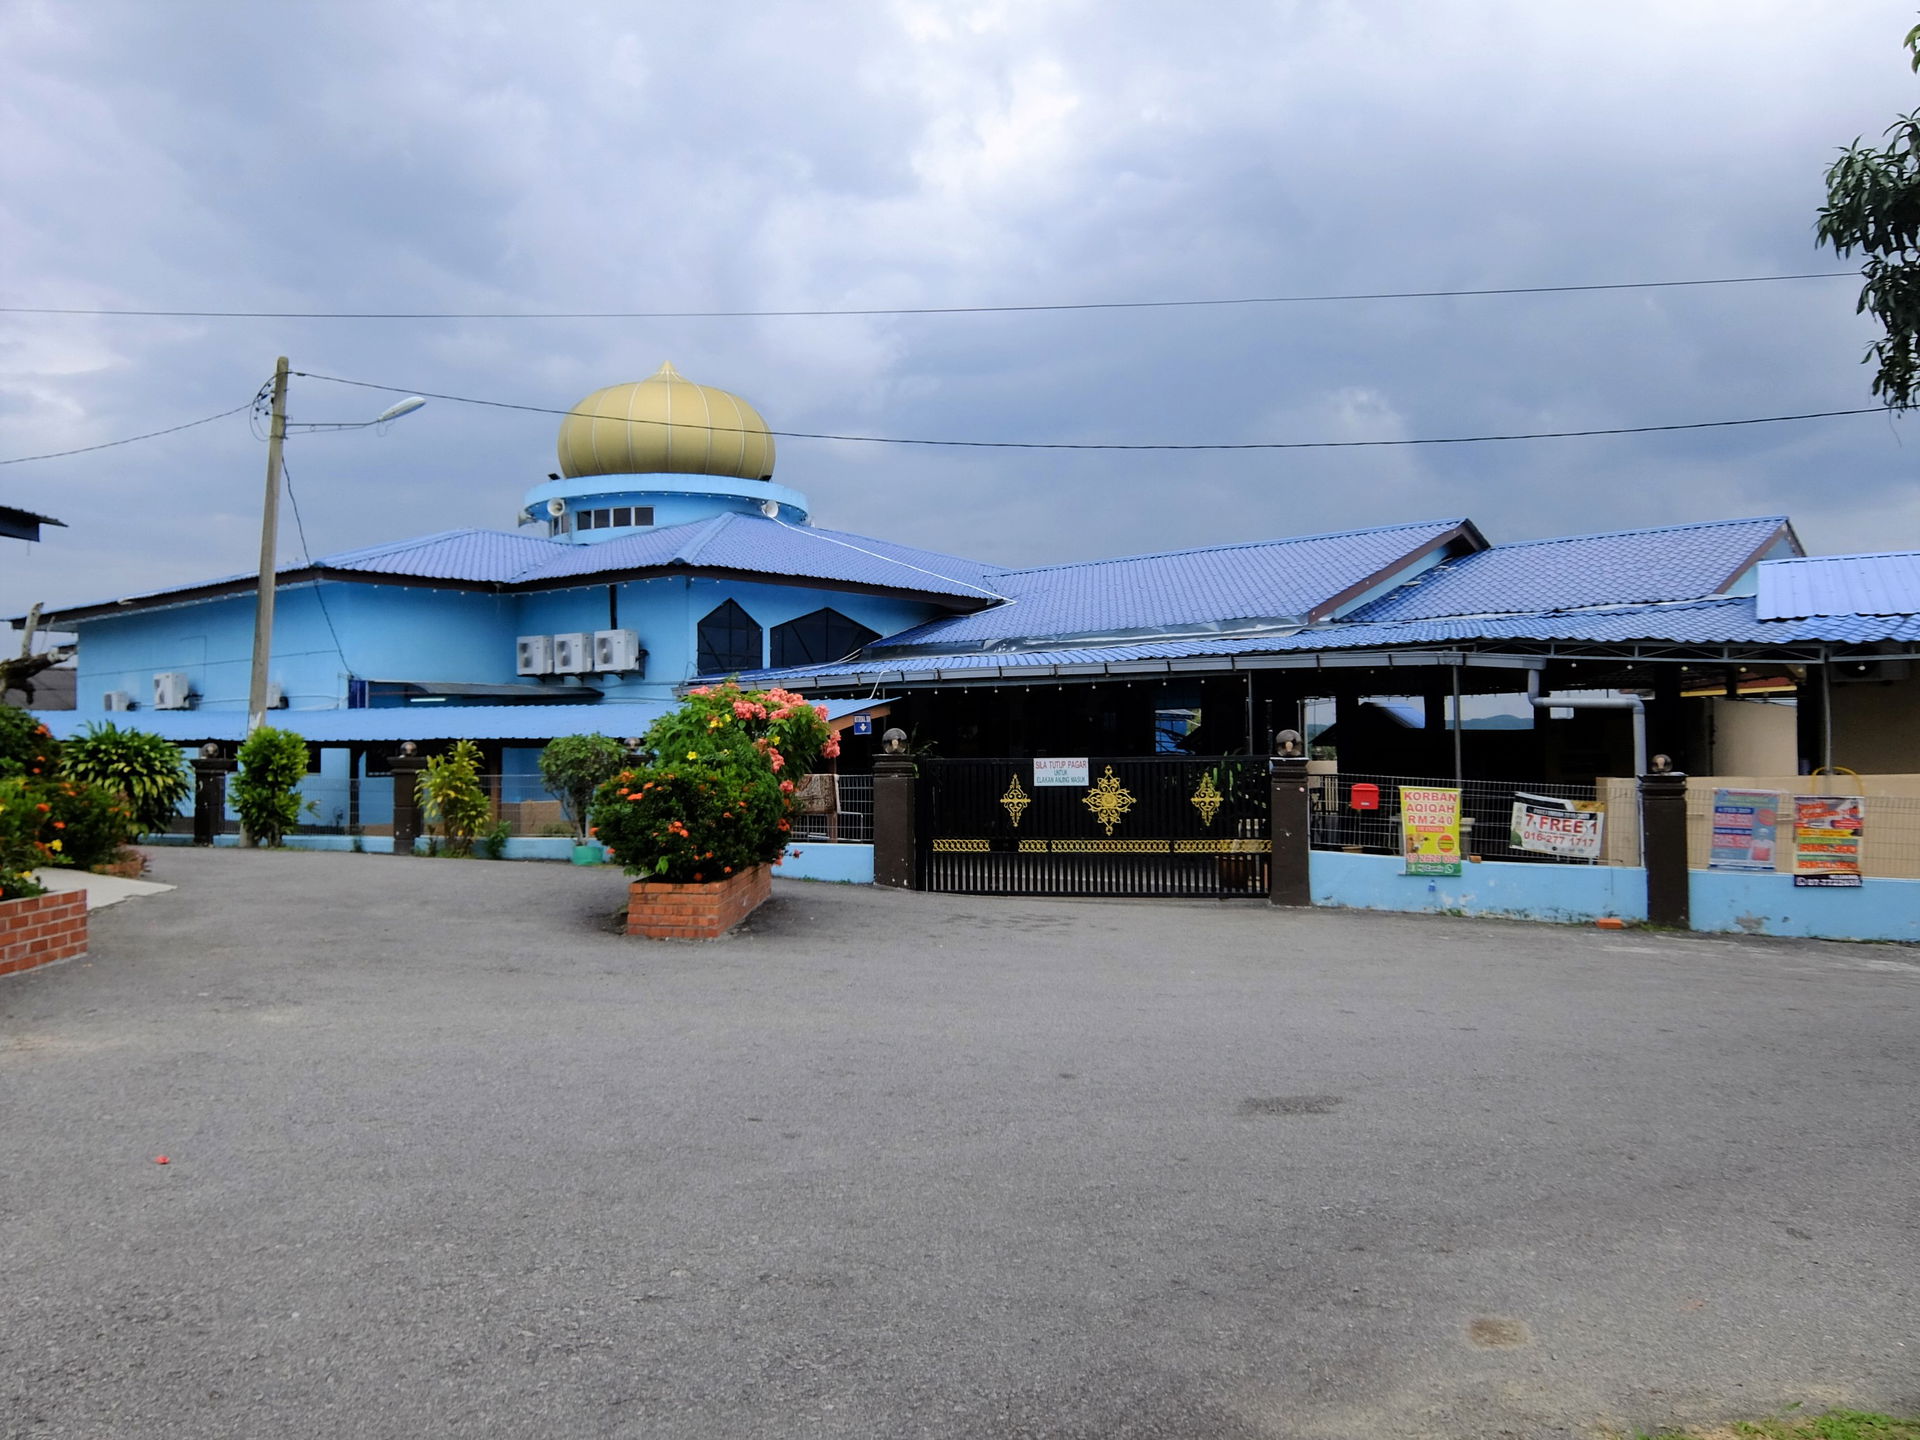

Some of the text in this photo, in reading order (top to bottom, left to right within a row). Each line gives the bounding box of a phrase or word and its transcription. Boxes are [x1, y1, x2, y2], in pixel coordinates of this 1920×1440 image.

[1049, 760, 1066, 769] TUTUP
[1067, 760, 1086, 769] PAGAR
[1404, 791, 1457, 802] KORBAN
[1406, 803, 1455, 813] AQIQAH
[1408, 815, 1453, 825] RM240
[1526, 814, 1535, 827] 7
[1539, 816, 1584, 834] FREE
[1590, 822, 1598, 835] 1
[1523, 831, 1565, 844] 016-277
[1568, 837, 1595, 847] 1717
